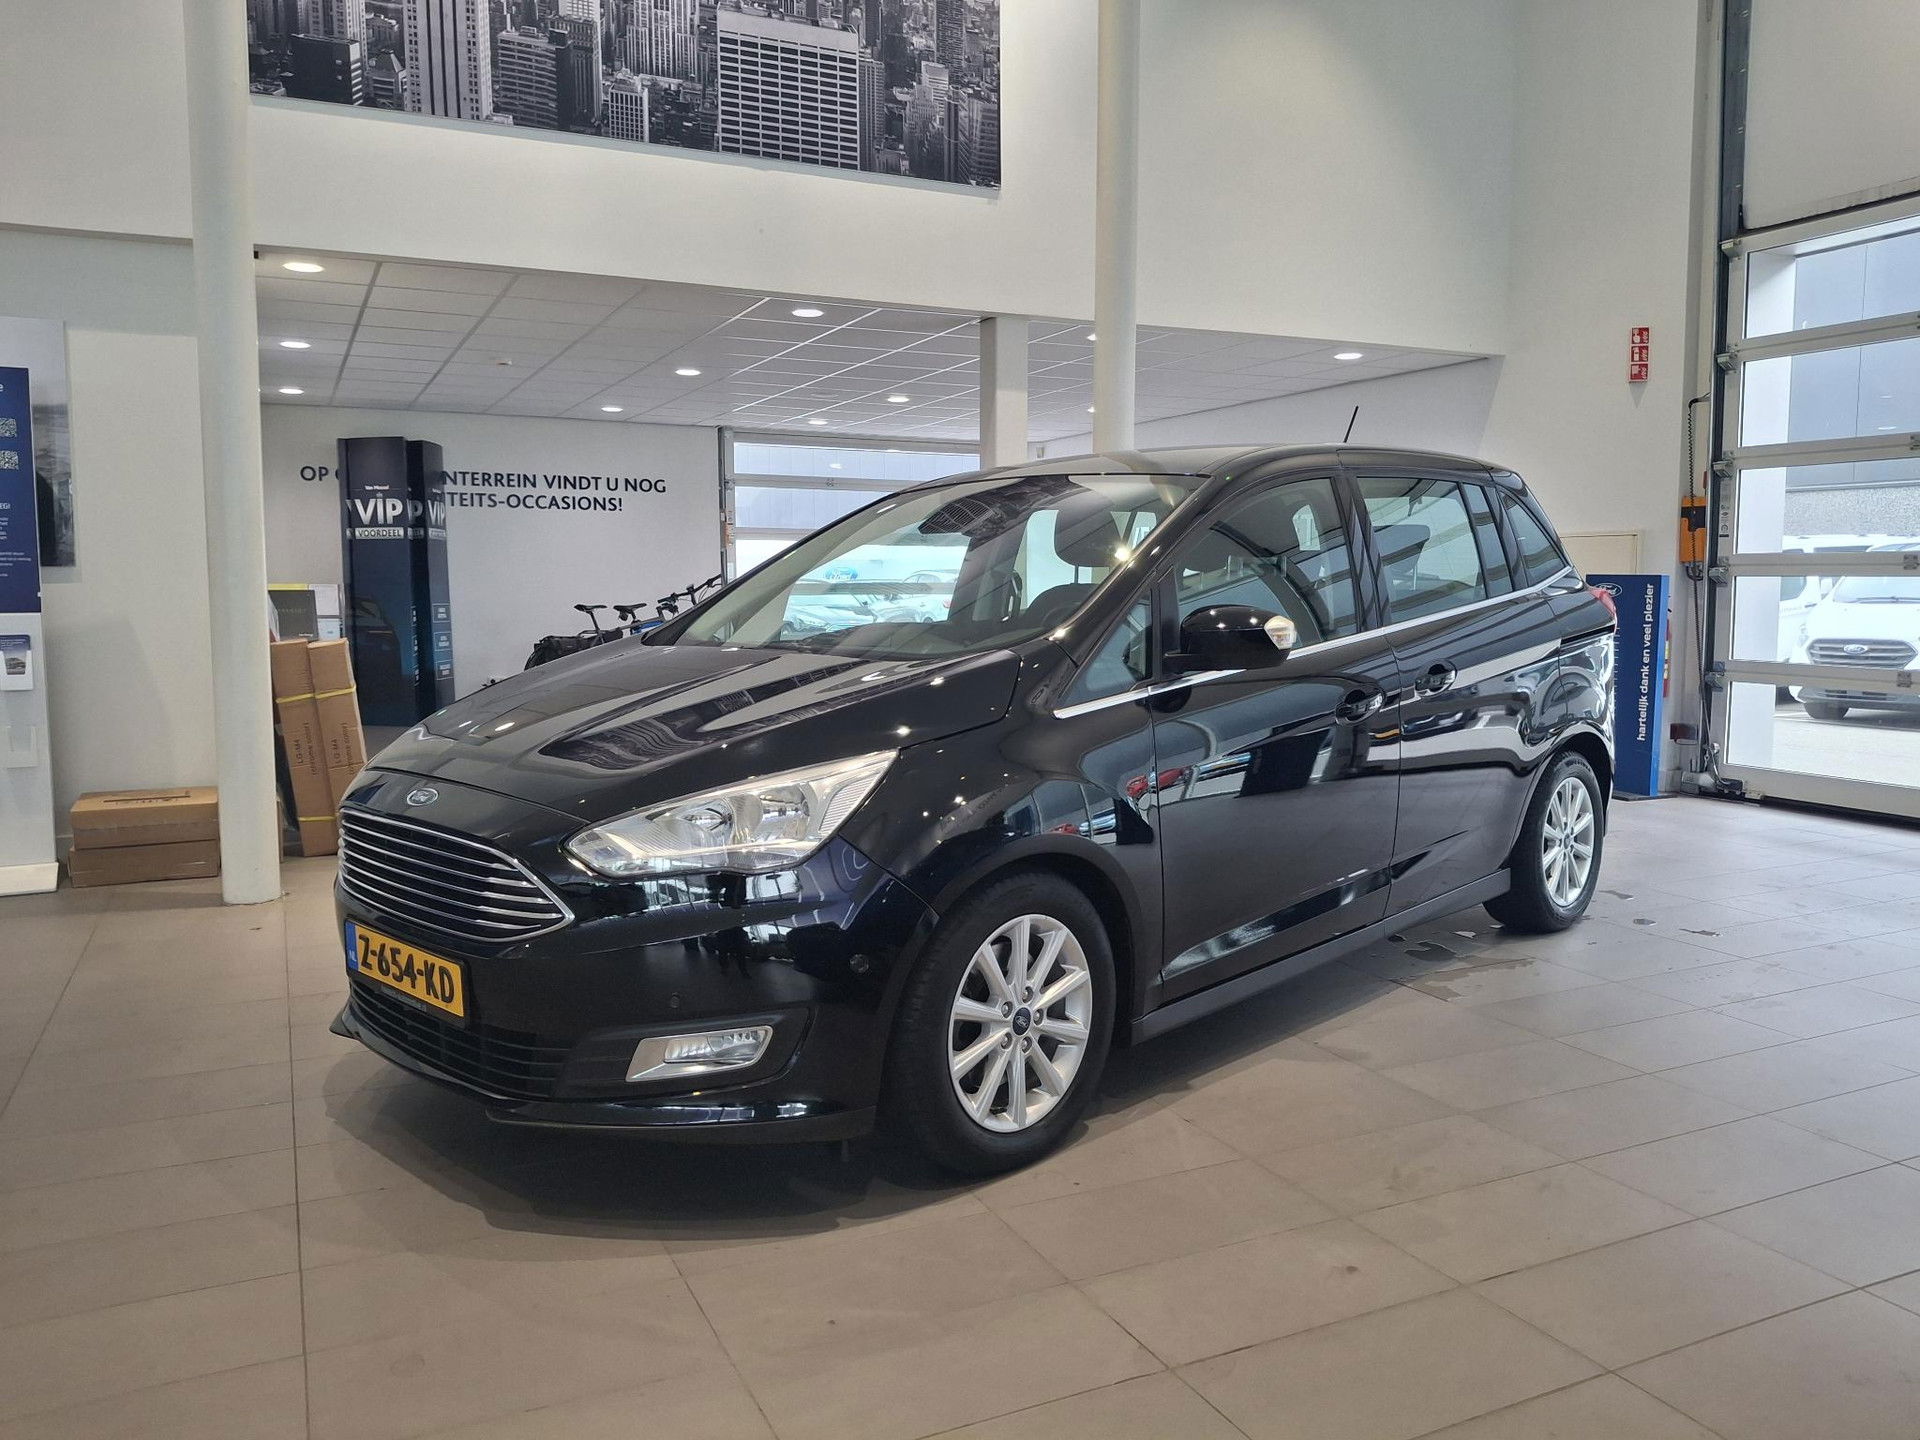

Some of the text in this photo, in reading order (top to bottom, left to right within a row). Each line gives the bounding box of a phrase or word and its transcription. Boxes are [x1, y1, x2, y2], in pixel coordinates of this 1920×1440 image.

[300, 465, 329, 482] OP
[442, 470, 667, 494] NTERREIN VINDT U NOG
[354, 498, 403, 525] VIP
[446, 491, 623, 512] TEITS-OCCASIONS!
[358, 528, 402, 538] VOORDEEL
[1636, 583, 1654, 742] hartelijk dank en veel plezier
[358, 933, 455, 1004] Z-654-KD
